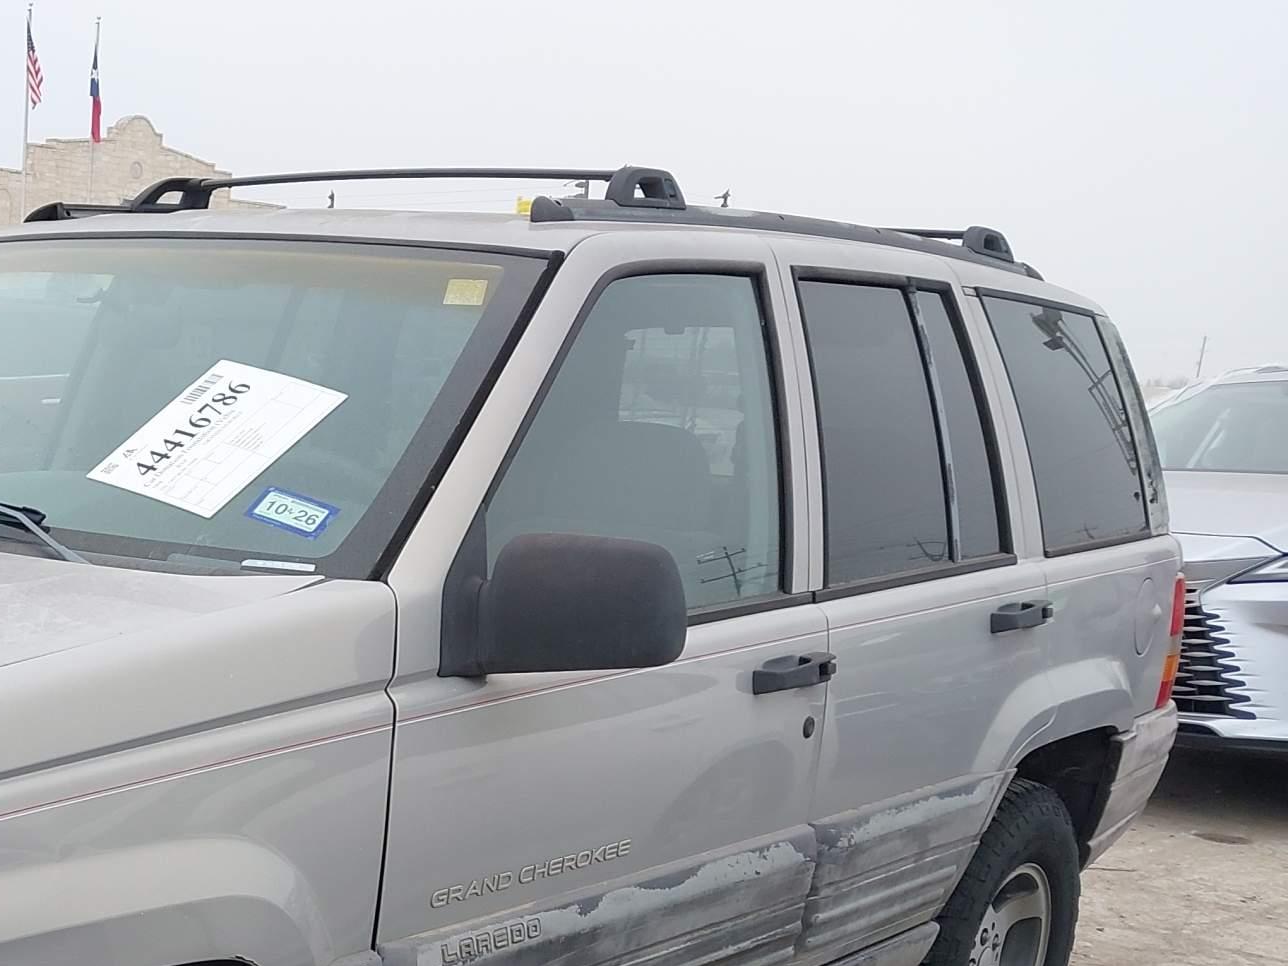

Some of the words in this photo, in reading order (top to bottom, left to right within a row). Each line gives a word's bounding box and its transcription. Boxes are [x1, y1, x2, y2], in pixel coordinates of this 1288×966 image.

[136, 380, 251, 476] 44416786
[430, 871, 513, 908] GRAND
[518, 839, 632, 884] CHEROKEE
[441, 917, 542, 966] LAREDO
